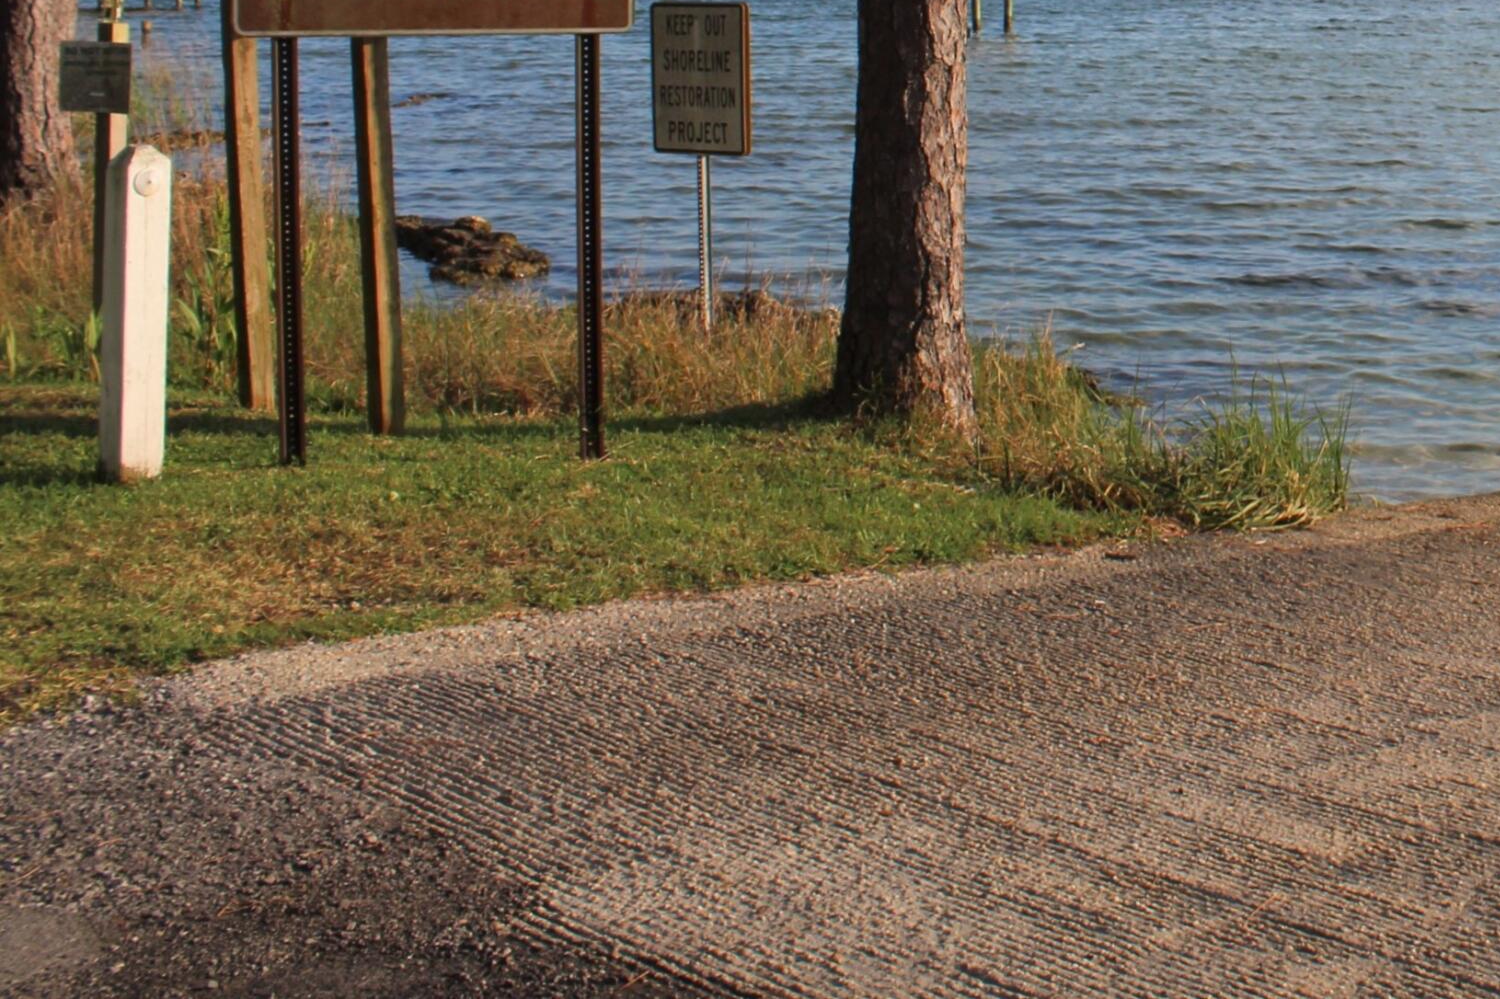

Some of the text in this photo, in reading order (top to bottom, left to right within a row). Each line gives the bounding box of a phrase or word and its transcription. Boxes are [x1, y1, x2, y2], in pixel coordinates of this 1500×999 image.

[666, 14, 726, 36] KEEP OUT
[663, 50, 731, 72] SHORELINE
[660, 85, 736, 107] RESTORATION
[668, 121, 728, 144] PROJECT
